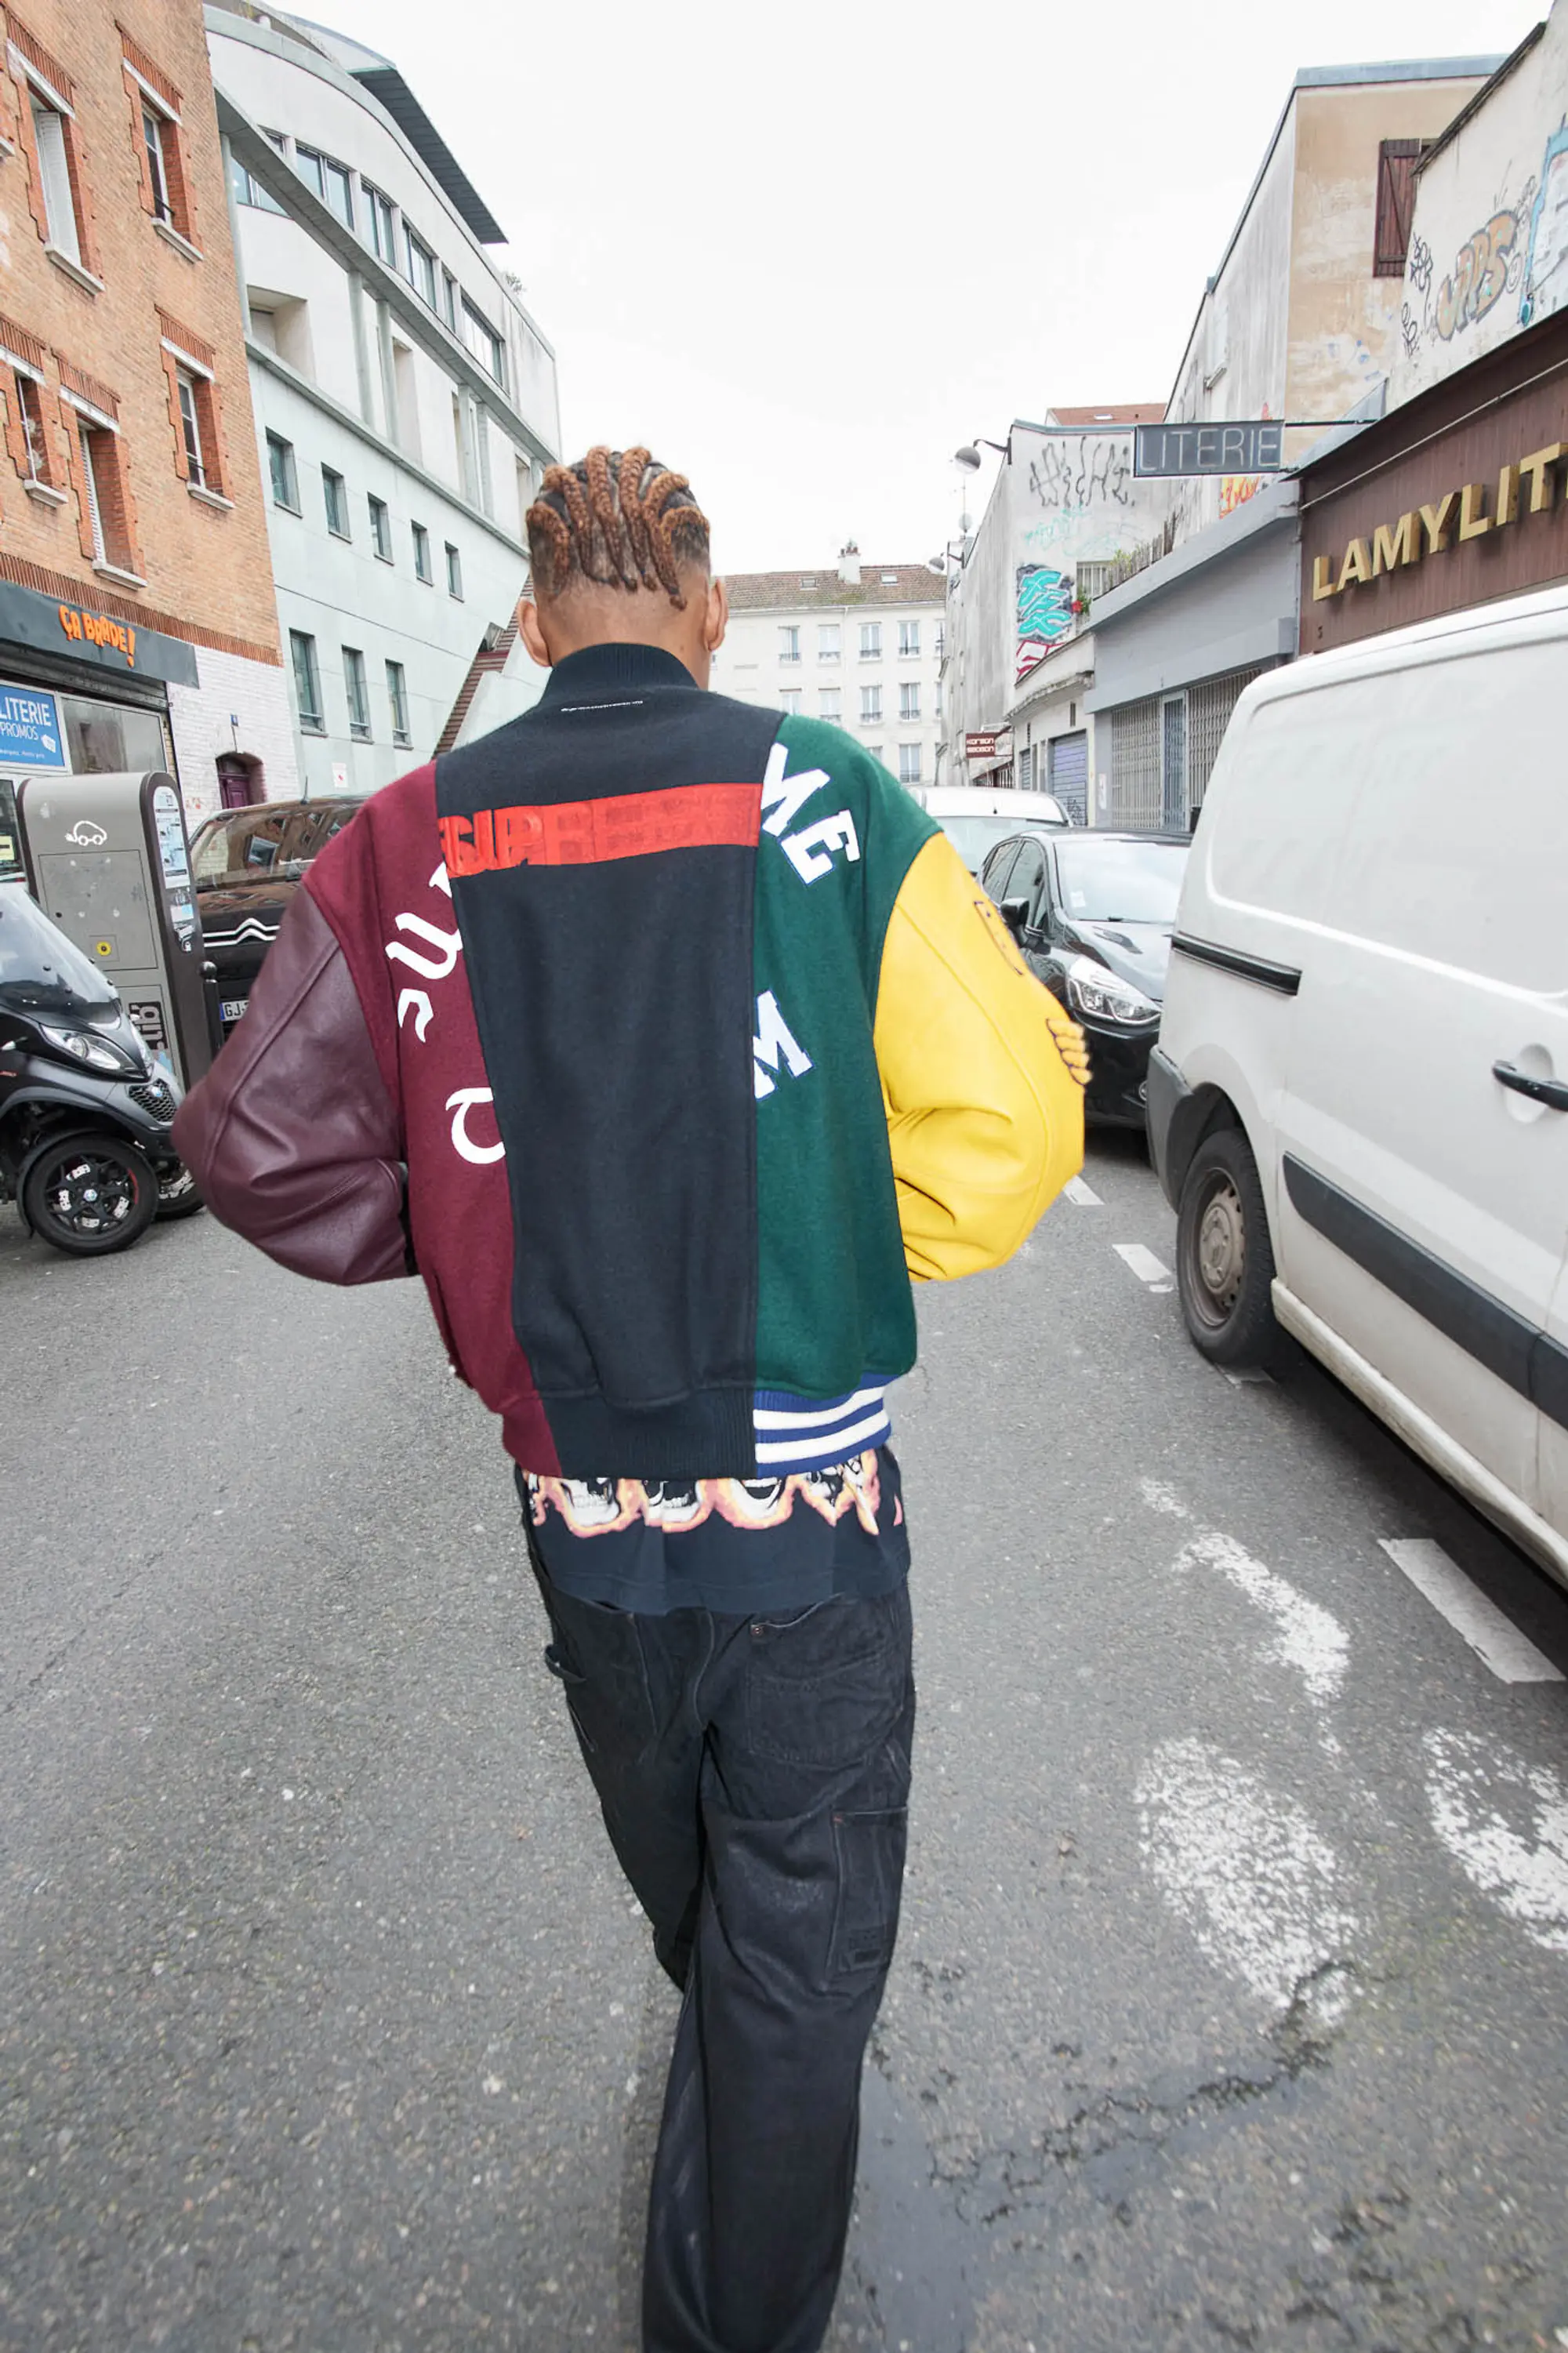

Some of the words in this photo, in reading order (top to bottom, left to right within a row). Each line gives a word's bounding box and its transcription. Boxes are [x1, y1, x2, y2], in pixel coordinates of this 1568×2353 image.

[1140, 427, 1279, 470] LITERIE
[1312, 442, 1568, 601] LAMYLIT
[224, 1000, 249, 1018] GJ-
